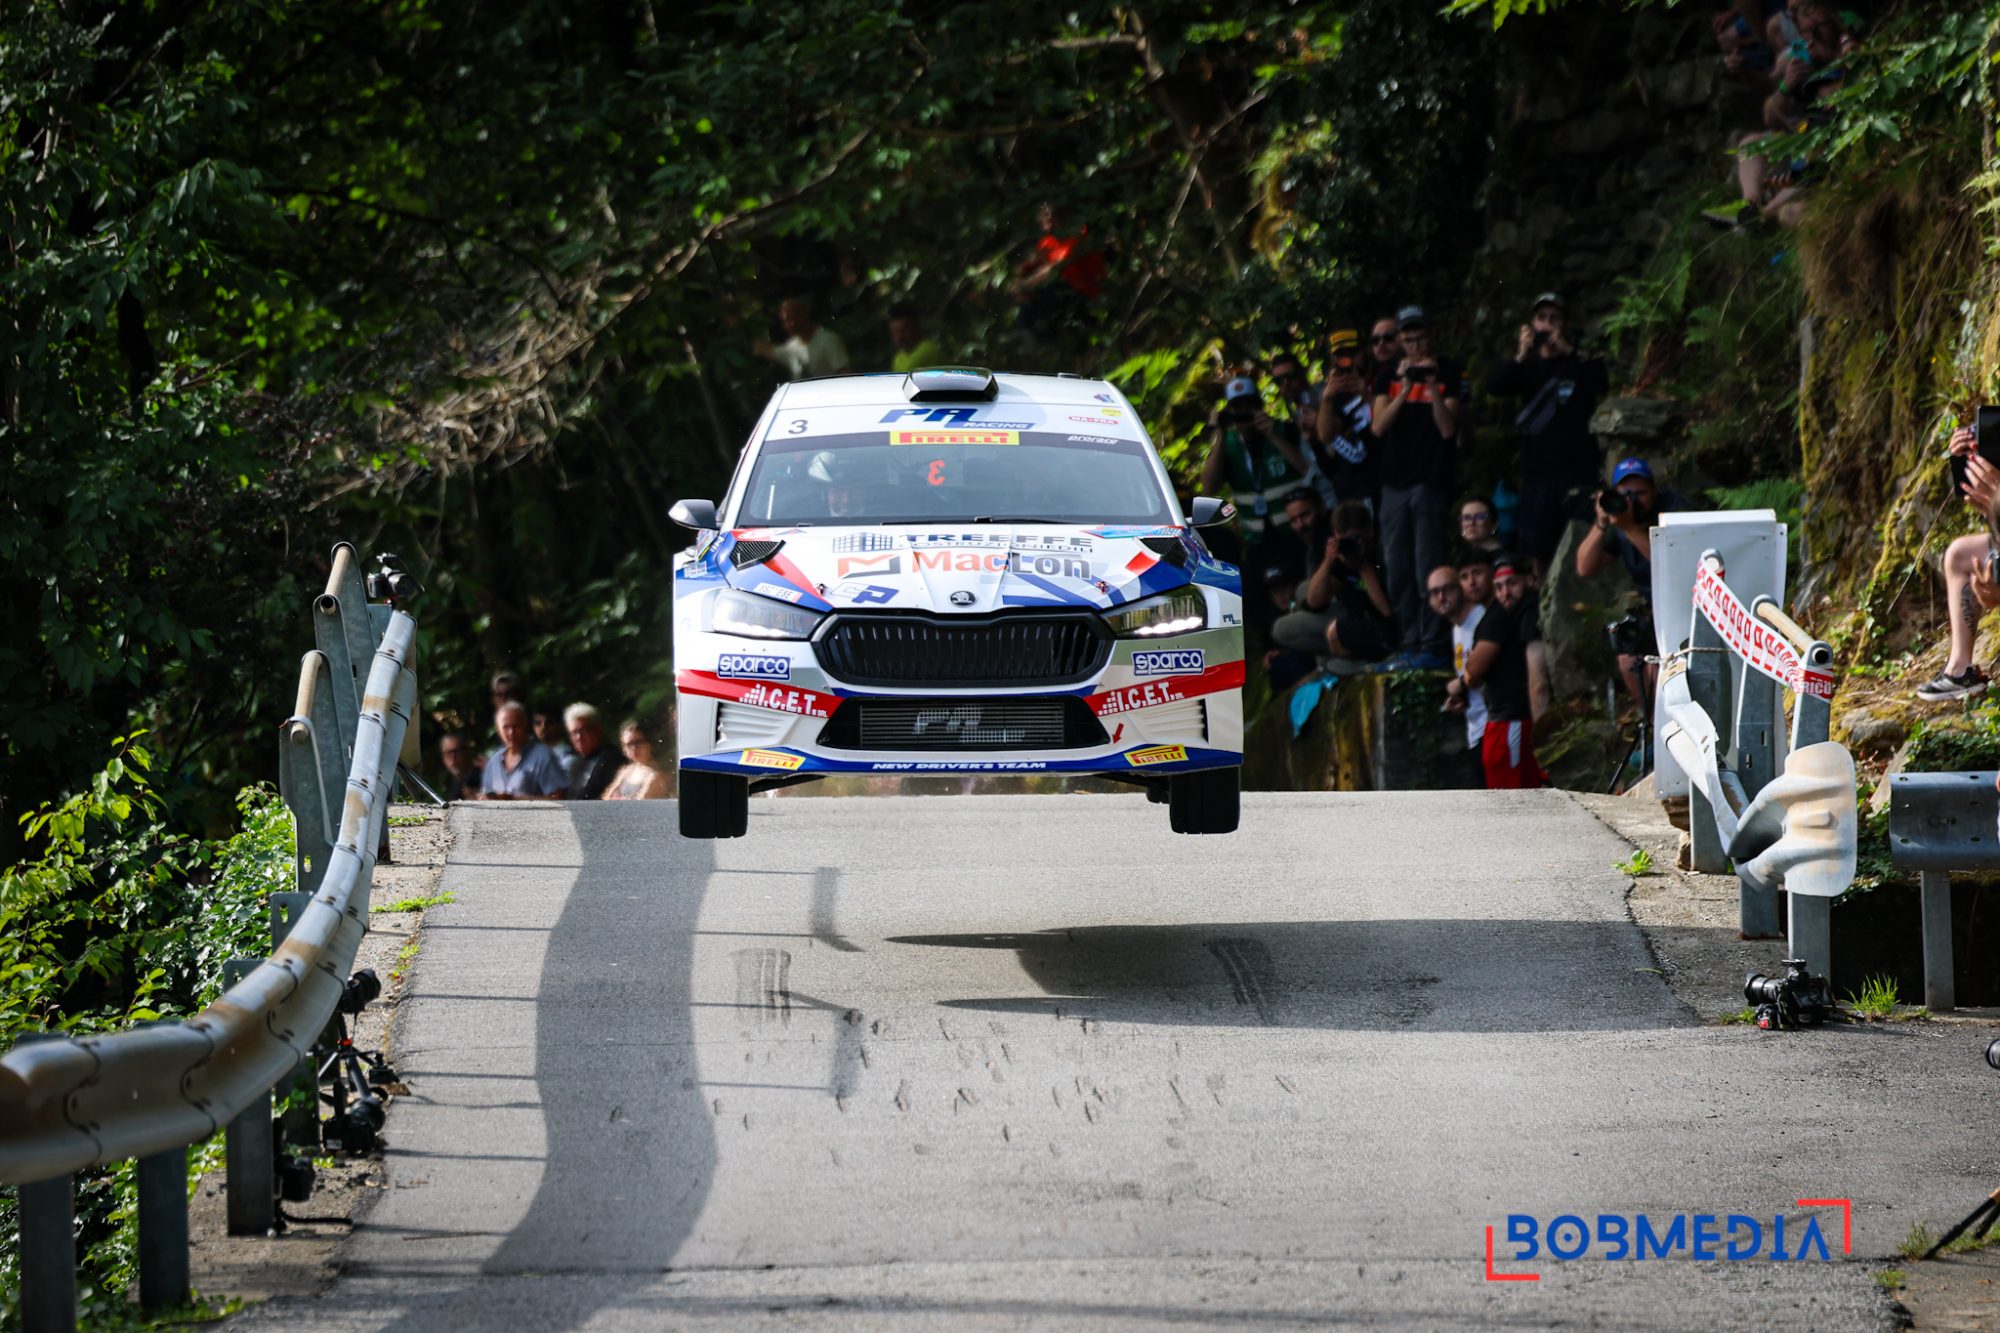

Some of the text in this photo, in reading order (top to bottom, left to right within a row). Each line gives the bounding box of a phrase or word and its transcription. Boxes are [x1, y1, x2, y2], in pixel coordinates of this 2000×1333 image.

[788, 419, 808, 434] 3
[899, 431, 1010, 444] PIRELLI
[899, 533, 1093, 547] TREEFFE
[912, 550, 1091, 579] MacLon
[720, 654, 789, 677] sparco
[1135, 651, 1202, 675] sparco
[758, 685, 817, 716] I.C.E.T.
[1117, 681, 1175, 711] I.C.E.T.
[745, 749, 799, 768] PIRELLI
[1130, 746, 1182, 765] PIRELLI
